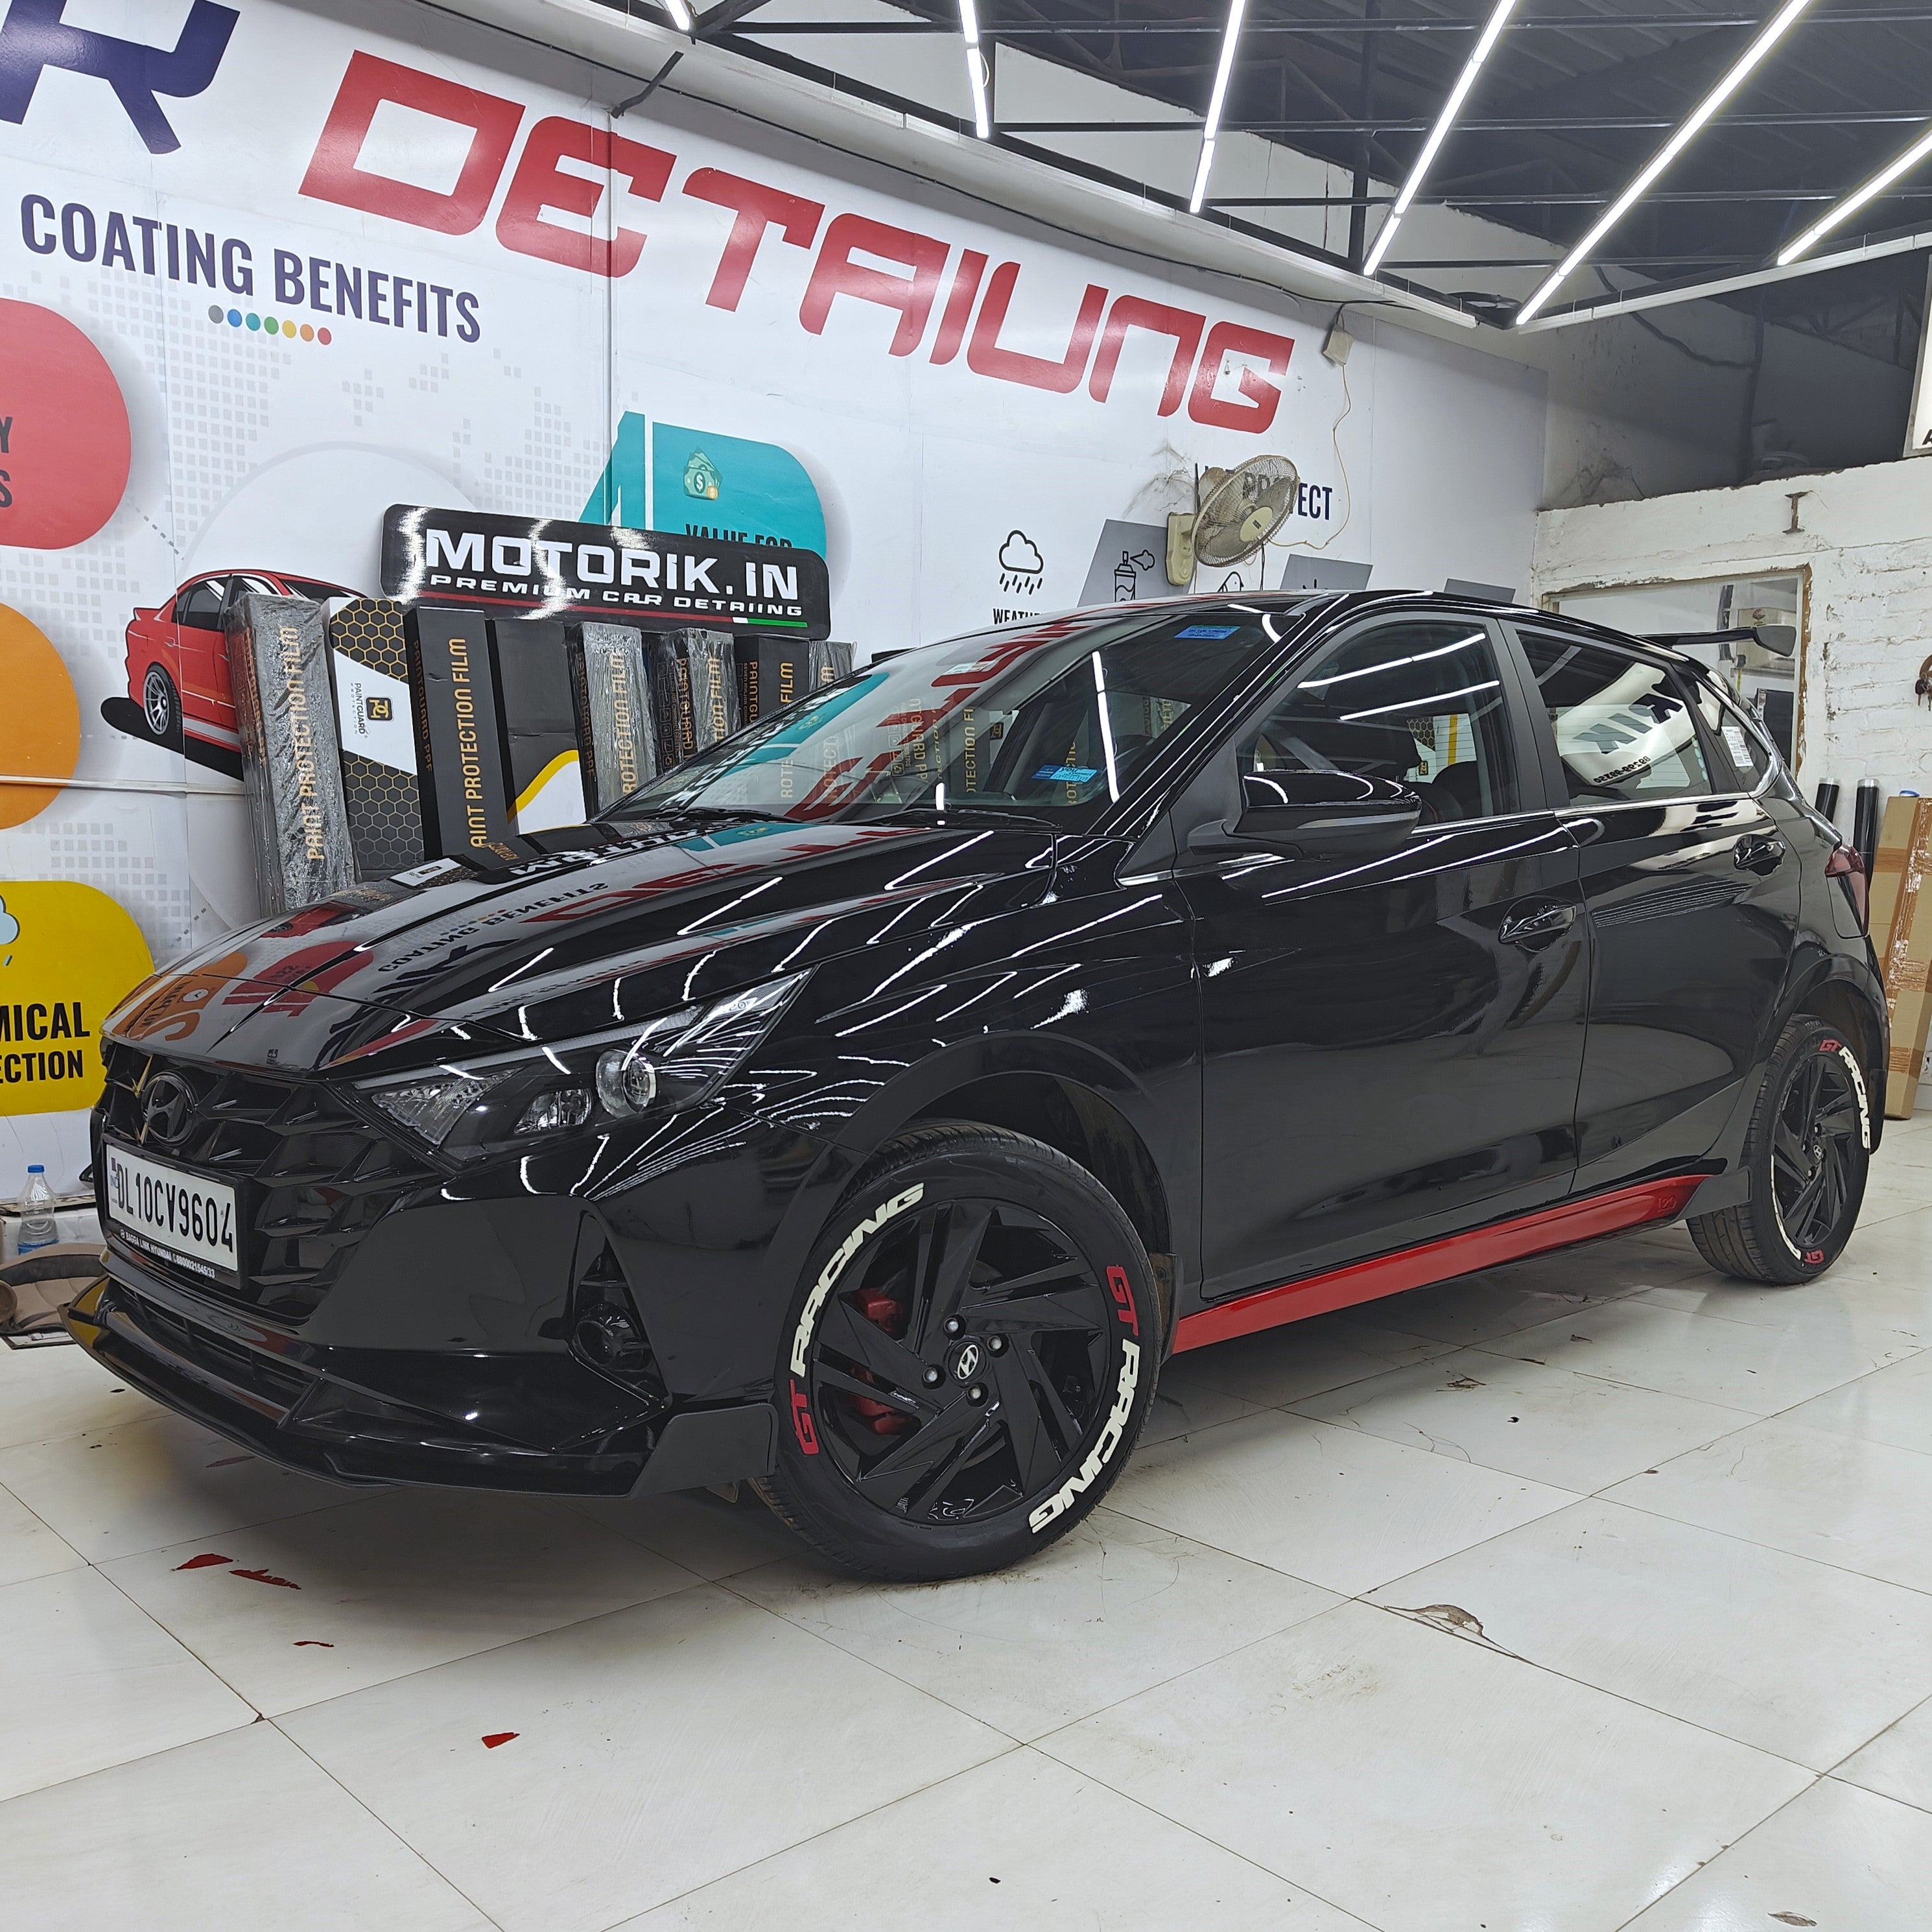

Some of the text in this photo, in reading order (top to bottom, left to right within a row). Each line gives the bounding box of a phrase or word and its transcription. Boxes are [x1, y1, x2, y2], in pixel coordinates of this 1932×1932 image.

[20, 193, 481, 344] COATING BENEFITS
[430, 574, 591, 600] PREMIUM
[602, 591, 663, 606] CAR
[448, 637, 471, 683] FILM
[609, 649, 628, 694] FILM
[780, 662, 794, 703] FILM
[355, 683, 366, 735] PAINTGUARD
[414, 639, 429, 740] PAINTGUARD
[287, 679, 318, 797] PROTECTION
[455, 688, 484, 800] PROTECTION
[301, 803, 325, 860] PAINT
[0, 1050, 83, 1084] CTION
[1839, 1046, 1871, 1149] RACING
[150, 1243, 172, 1261] HYUNDAI
[790, 1183, 924, 1455] GT RACING
[1028, 1264, 1140, 1534] GT RACING
